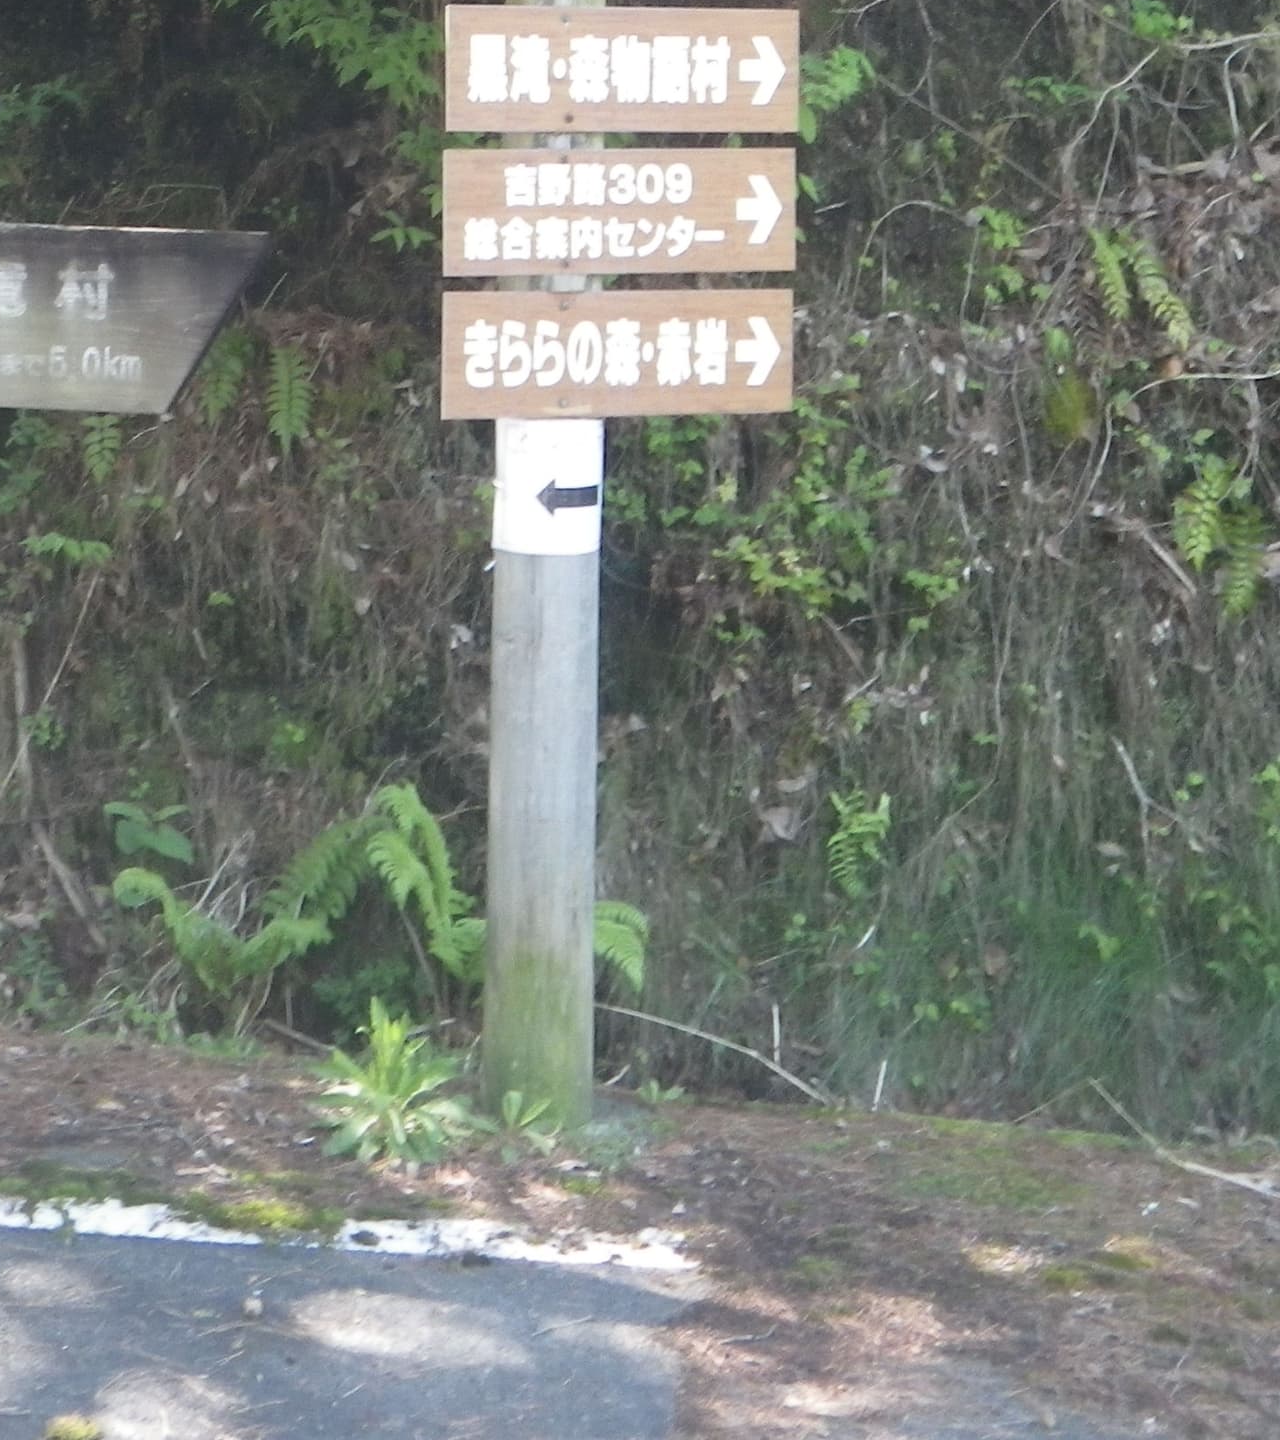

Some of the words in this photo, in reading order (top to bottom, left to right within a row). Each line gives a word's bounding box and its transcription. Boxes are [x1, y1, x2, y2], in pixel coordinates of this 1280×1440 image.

[504, 163, 693, 206] 吉野路309
[464, 216, 725, 260] 総合案内センター
[464, 318, 729, 388] きららの森・赤岩
